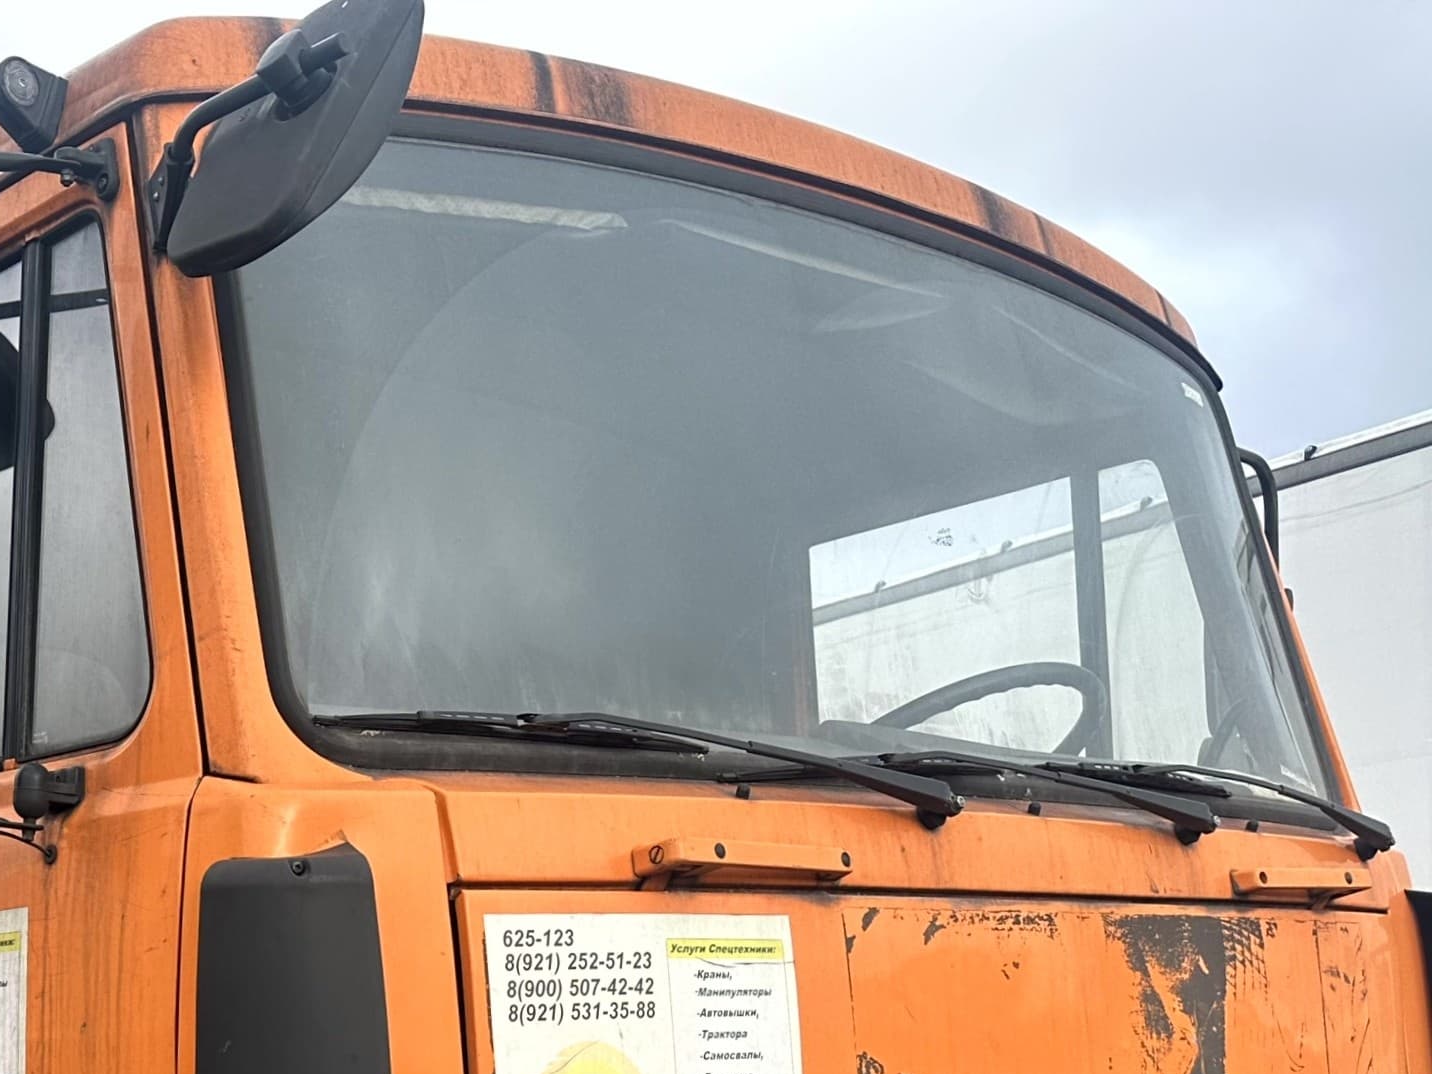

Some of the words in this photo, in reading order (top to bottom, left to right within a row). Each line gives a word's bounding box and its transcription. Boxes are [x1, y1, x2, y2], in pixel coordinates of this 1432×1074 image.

[503, 929, 575, 948] 625-123
[669, 943, 706, 956] Услуги
[708, 944, 777, 955] Спецтехники:
[505, 953, 561, 975] 8(921)
[568, 952, 653, 971] 252-51-23
[693, 969, 733, 981] -Краны,
[506, 979, 563, 1002] 8(900)
[569, 978, 655, 997] 507-42-42
[508, 1003, 565, 1026] 8(921)
[570, 1001, 656, 1022] 531-35-88
[696, 1008, 759, 1019] -Автовышки,
[698, 1029, 748, 1041] -Трактора
